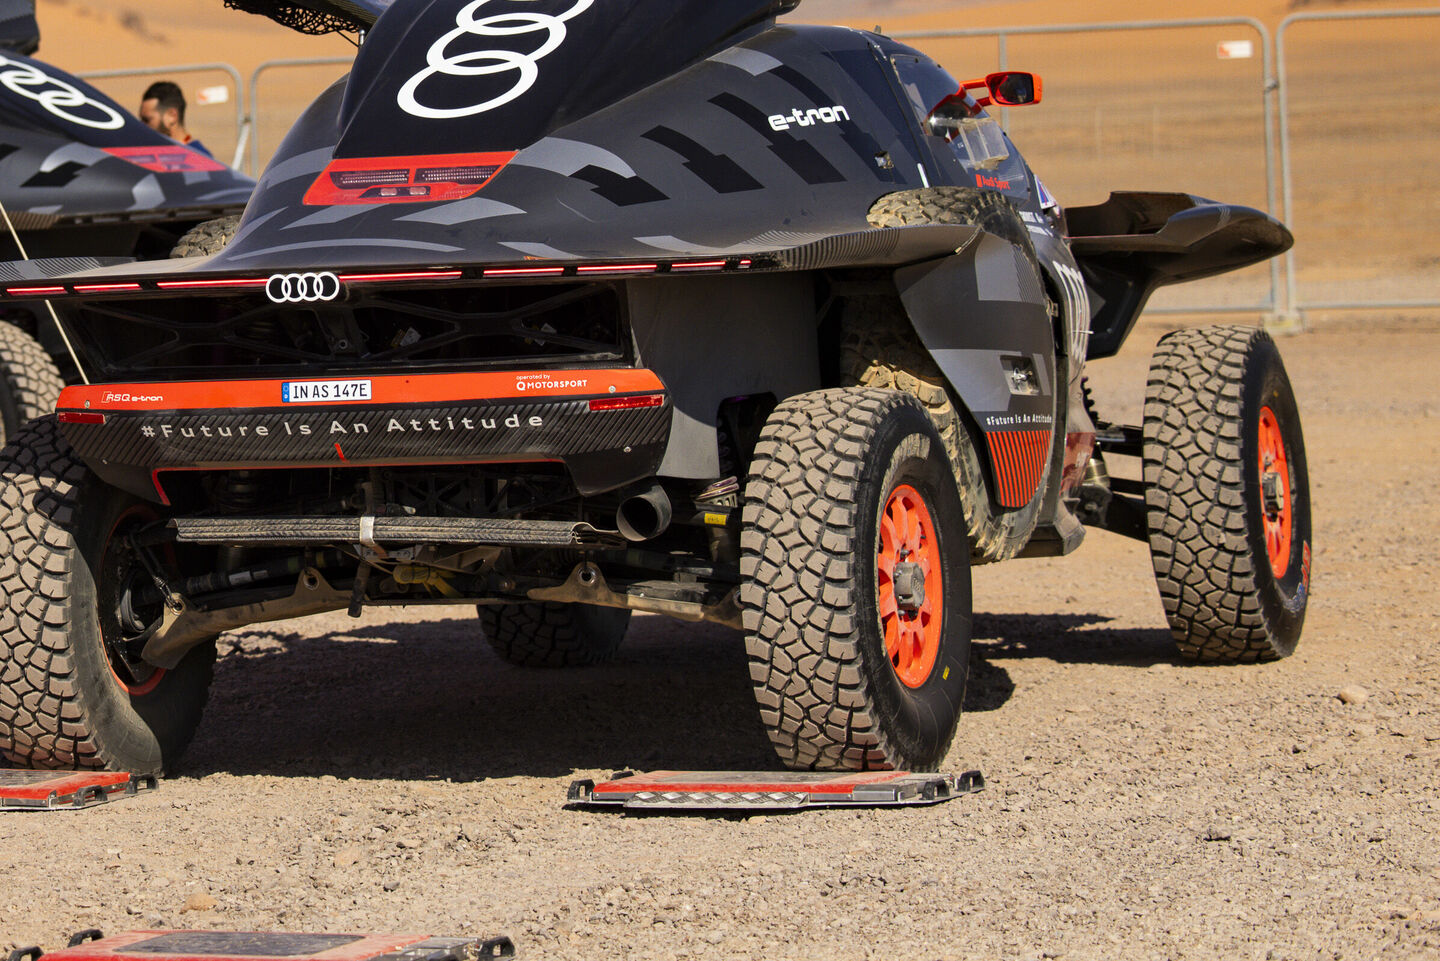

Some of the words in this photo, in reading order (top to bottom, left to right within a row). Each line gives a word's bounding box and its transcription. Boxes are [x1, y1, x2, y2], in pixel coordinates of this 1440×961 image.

[767, 105, 850, 132] e-tron
[515, 374, 543, 382] operated
[527, 380, 588, 390] MOTORSPORT
[293, 385, 308, 399] IN
[312, 384, 329, 399] AS
[333, 383, 368, 398] 147E
[141, 424, 269, 439] #Future
[284, 421, 312, 436] Is
[329, 420, 369, 434] An
[387, 414, 543, 432] Attitude
